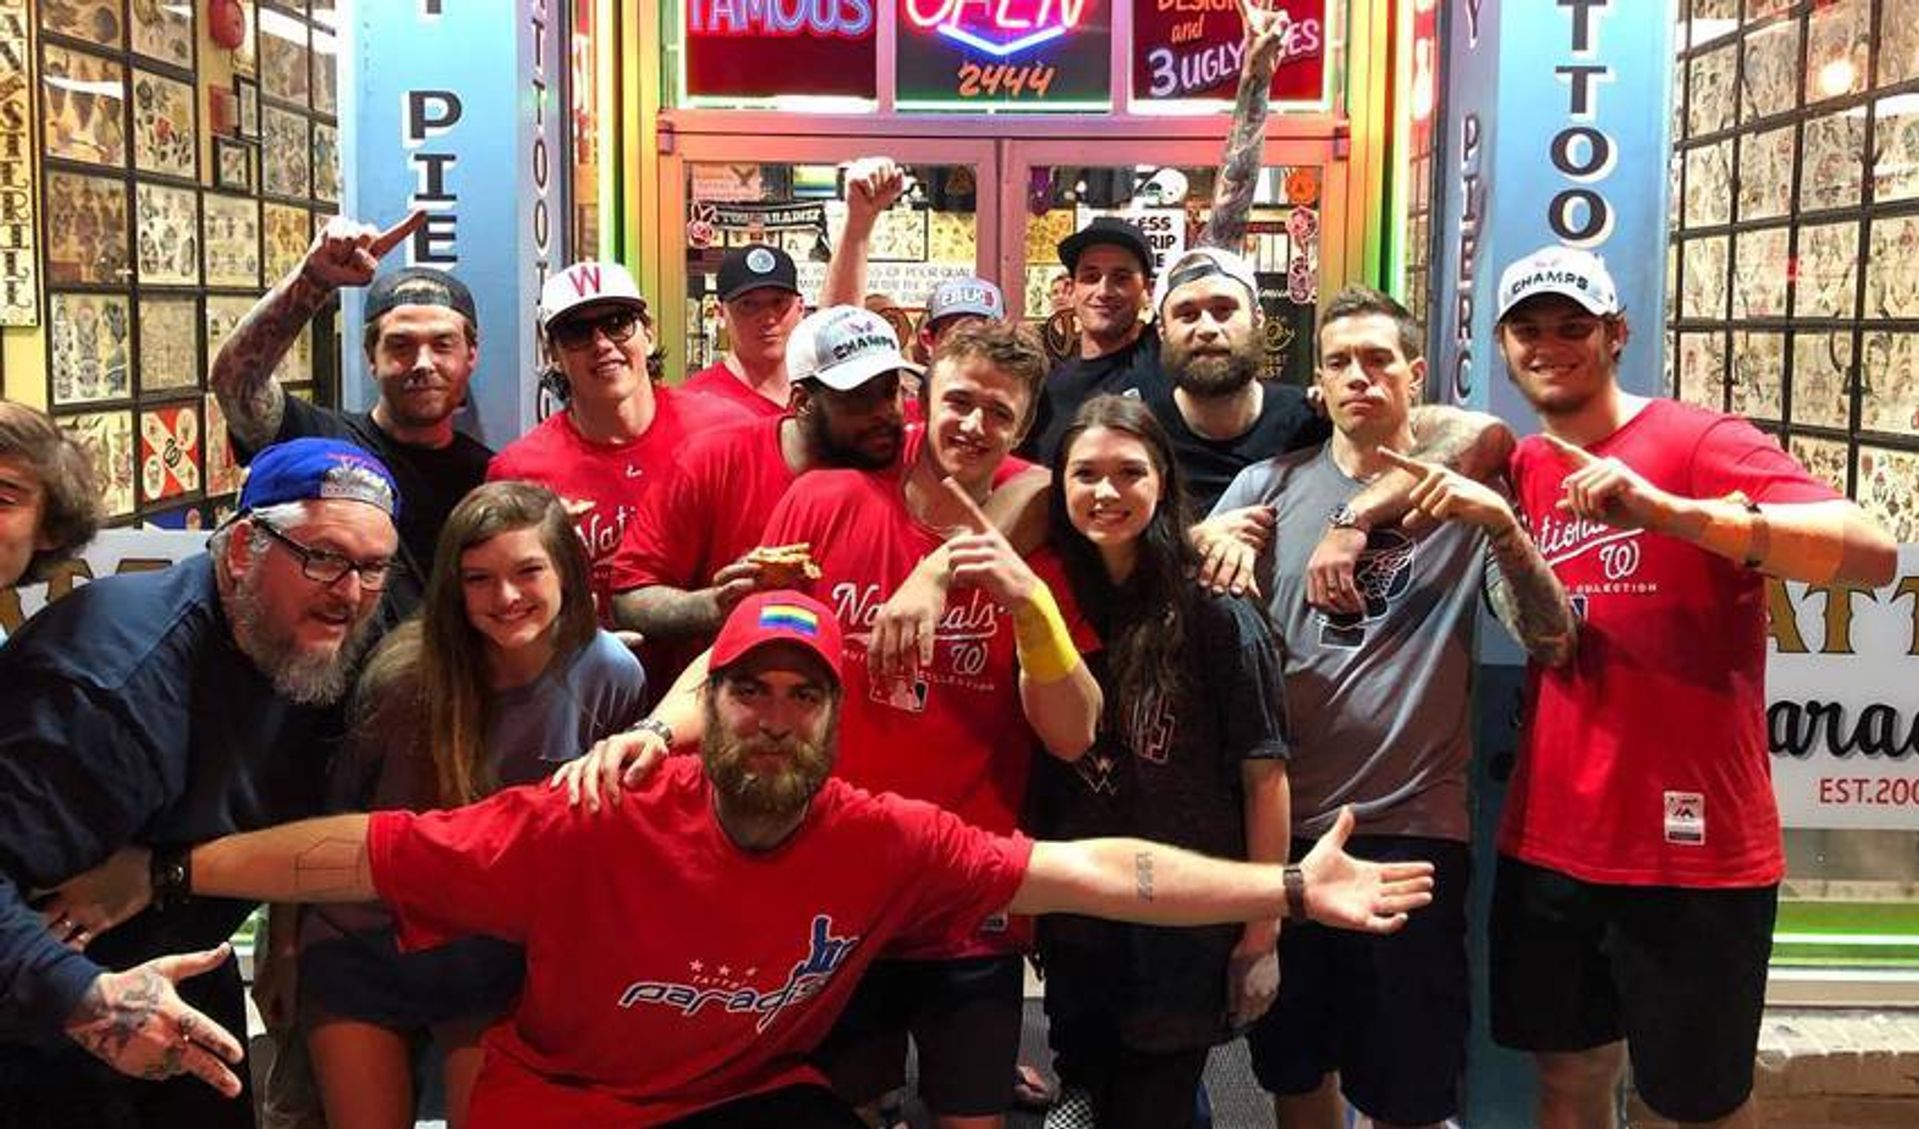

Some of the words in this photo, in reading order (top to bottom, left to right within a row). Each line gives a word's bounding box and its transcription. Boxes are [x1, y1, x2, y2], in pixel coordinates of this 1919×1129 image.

[1171, 14, 1205, 43] and
[957, 63, 1056, 97] 2444
[1149, 48, 1178, 97] 3
[1137, 216, 1172, 232] ESS
[1146, 234, 1176, 250] RIP
[571, 268, 601, 298] W
[1511, 270, 1589, 295] CHAMPS
[574, 504, 637, 559] Nat
[832, 581, 998, 638] Naals
[1767, 700, 1919, 758] ara
